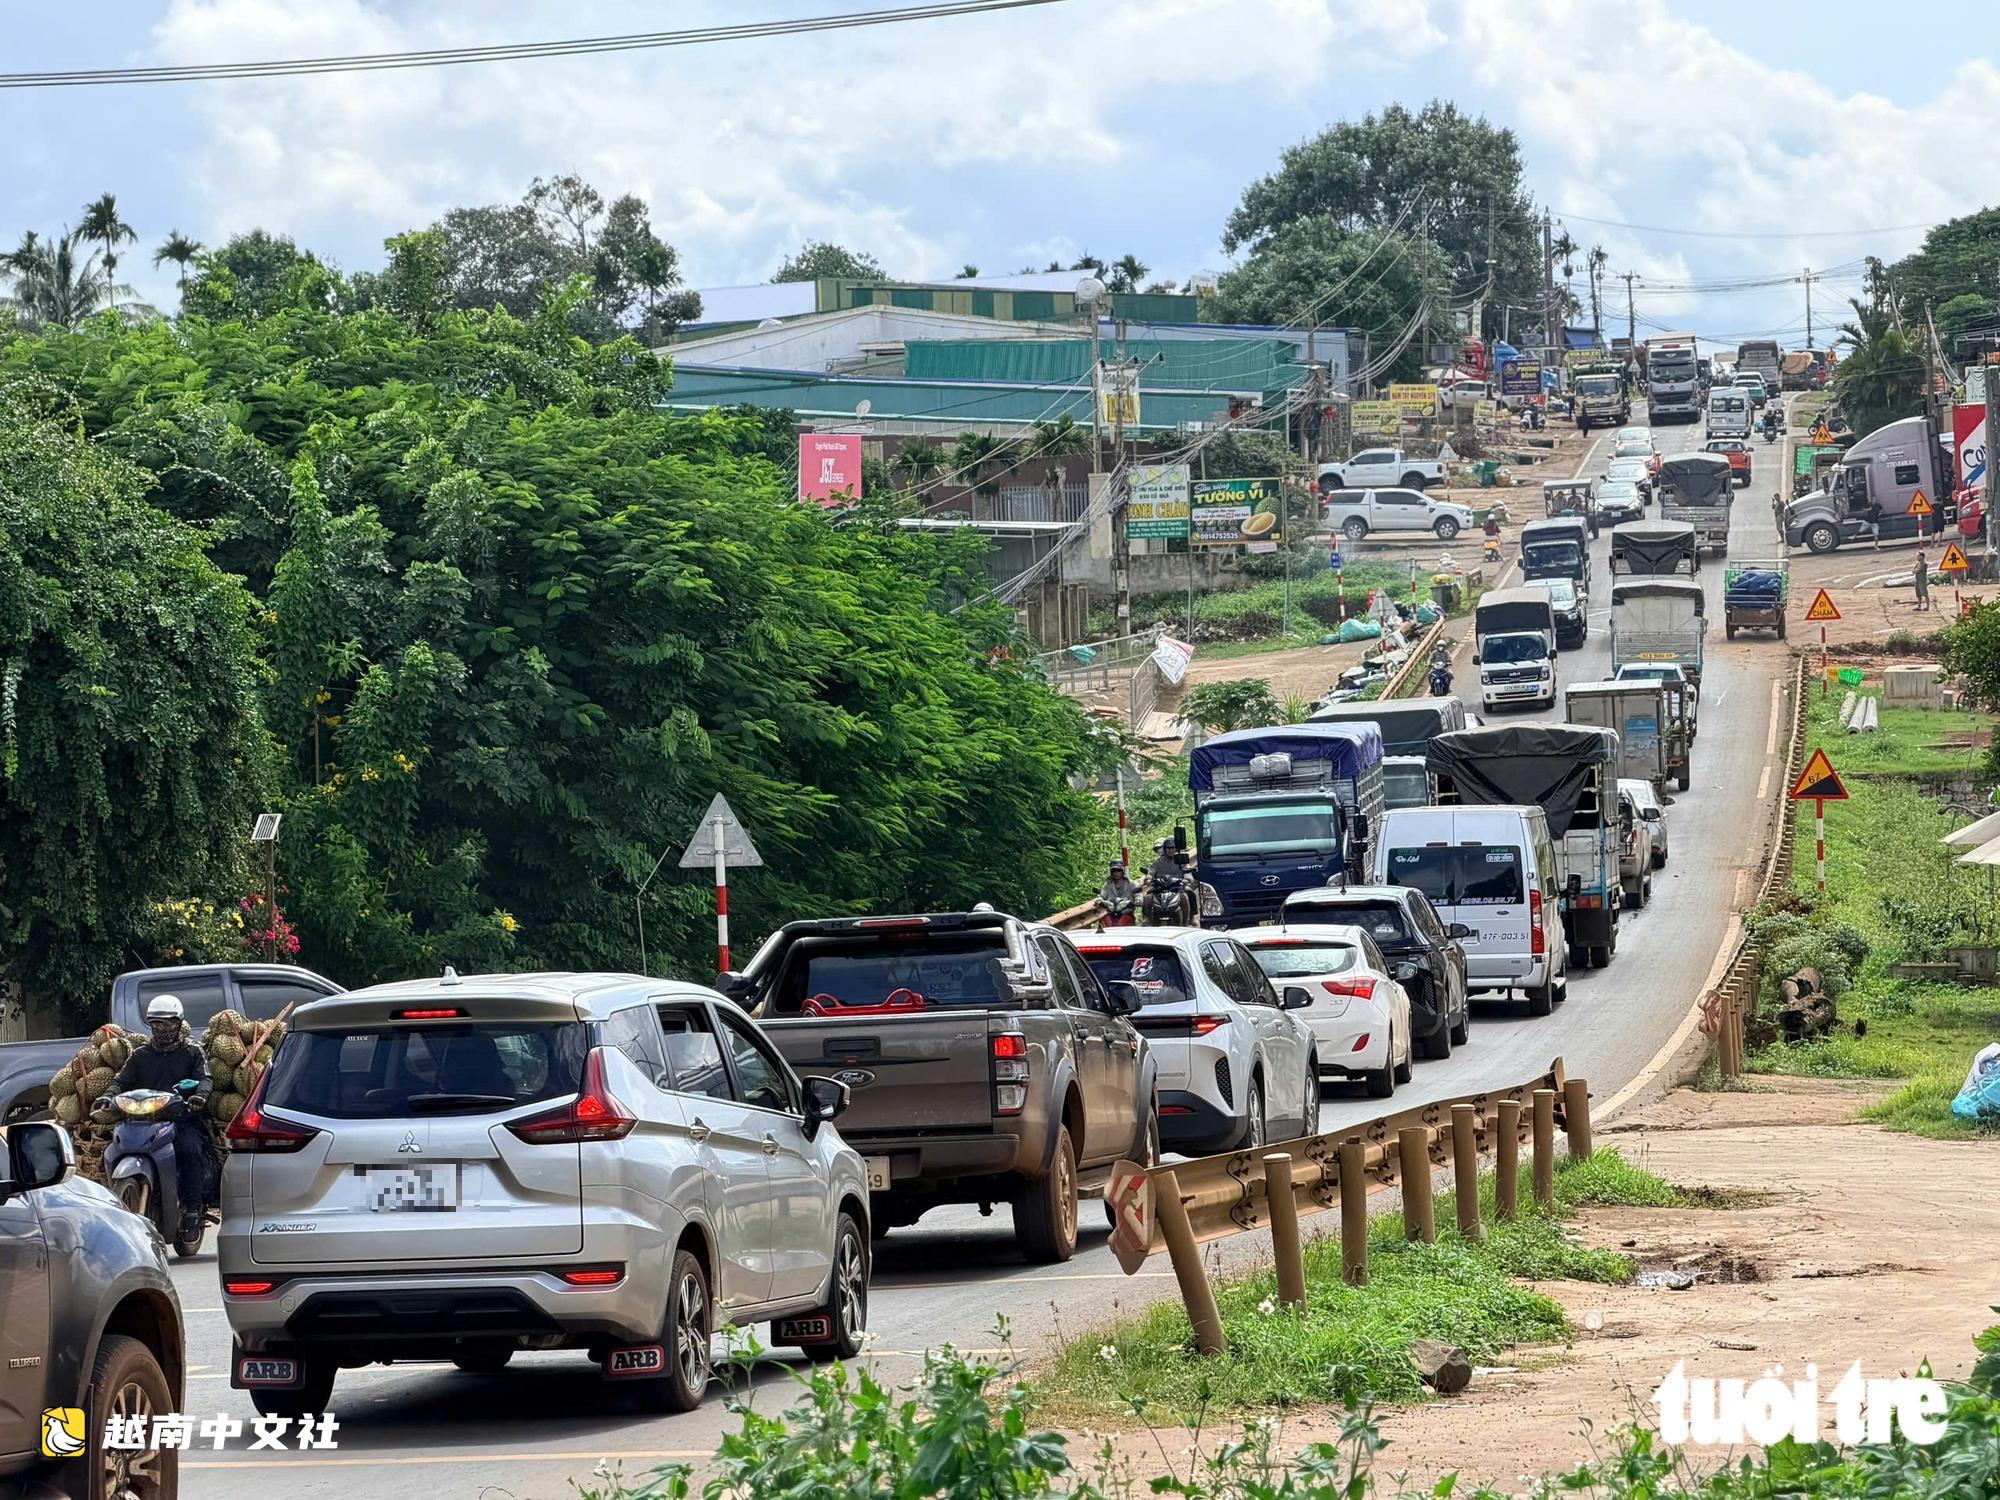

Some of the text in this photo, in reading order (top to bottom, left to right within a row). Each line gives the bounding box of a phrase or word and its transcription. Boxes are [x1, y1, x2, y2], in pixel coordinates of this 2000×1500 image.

[1193, 489, 1246, 504] TƯỜNG
[839, 1071, 865, 1084] Ford
[257, 1222, 317, 1233] XPANDER
[783, 1321, 824, 1337] ARB
[9, 1356, 41, 1369] COLORADO
[613, 1350, 659, 1370] ARB
[243, 1362, 292, 1379] ARB
